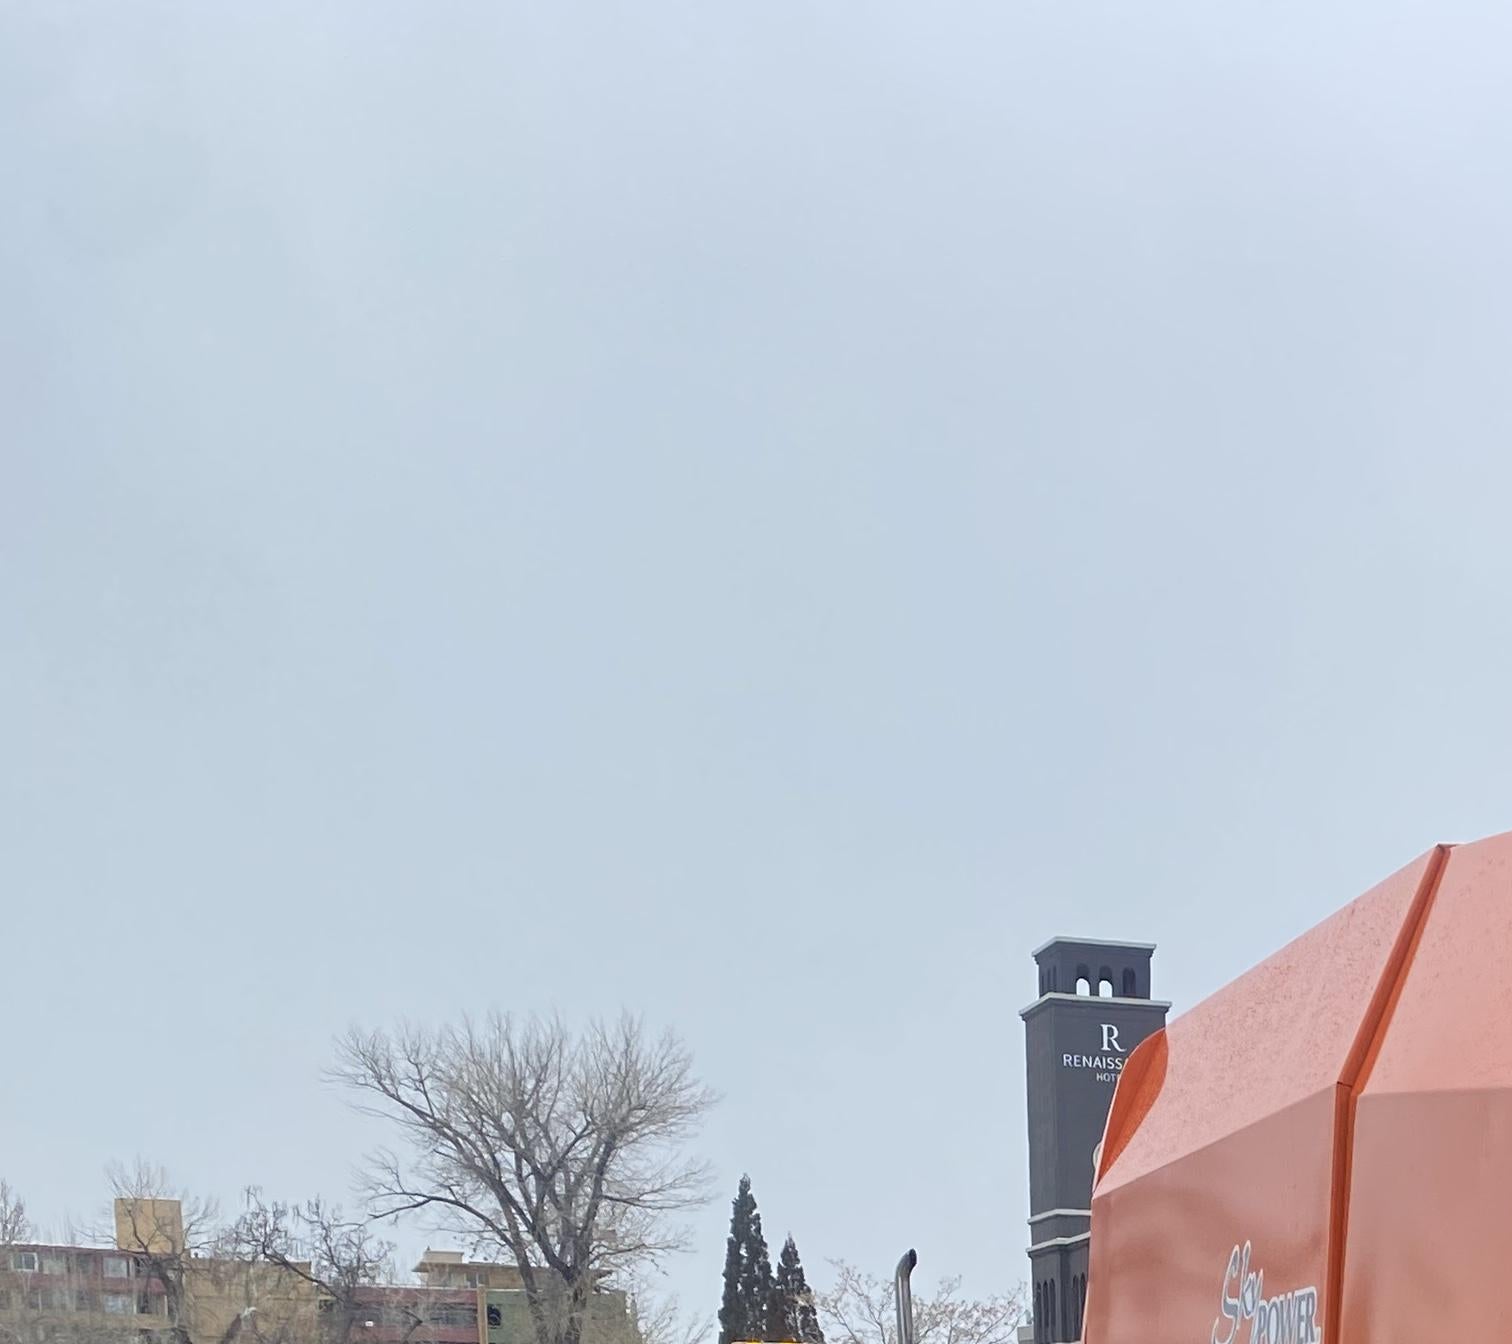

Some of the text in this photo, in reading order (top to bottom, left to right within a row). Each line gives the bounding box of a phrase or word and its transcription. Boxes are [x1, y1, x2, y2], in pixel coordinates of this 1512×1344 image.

[1100, 1024, 1127, 1052] R
[1063, 1054, 1123, 1070] RENAISS
[1096, 1073, 1120, 1082] HOT
